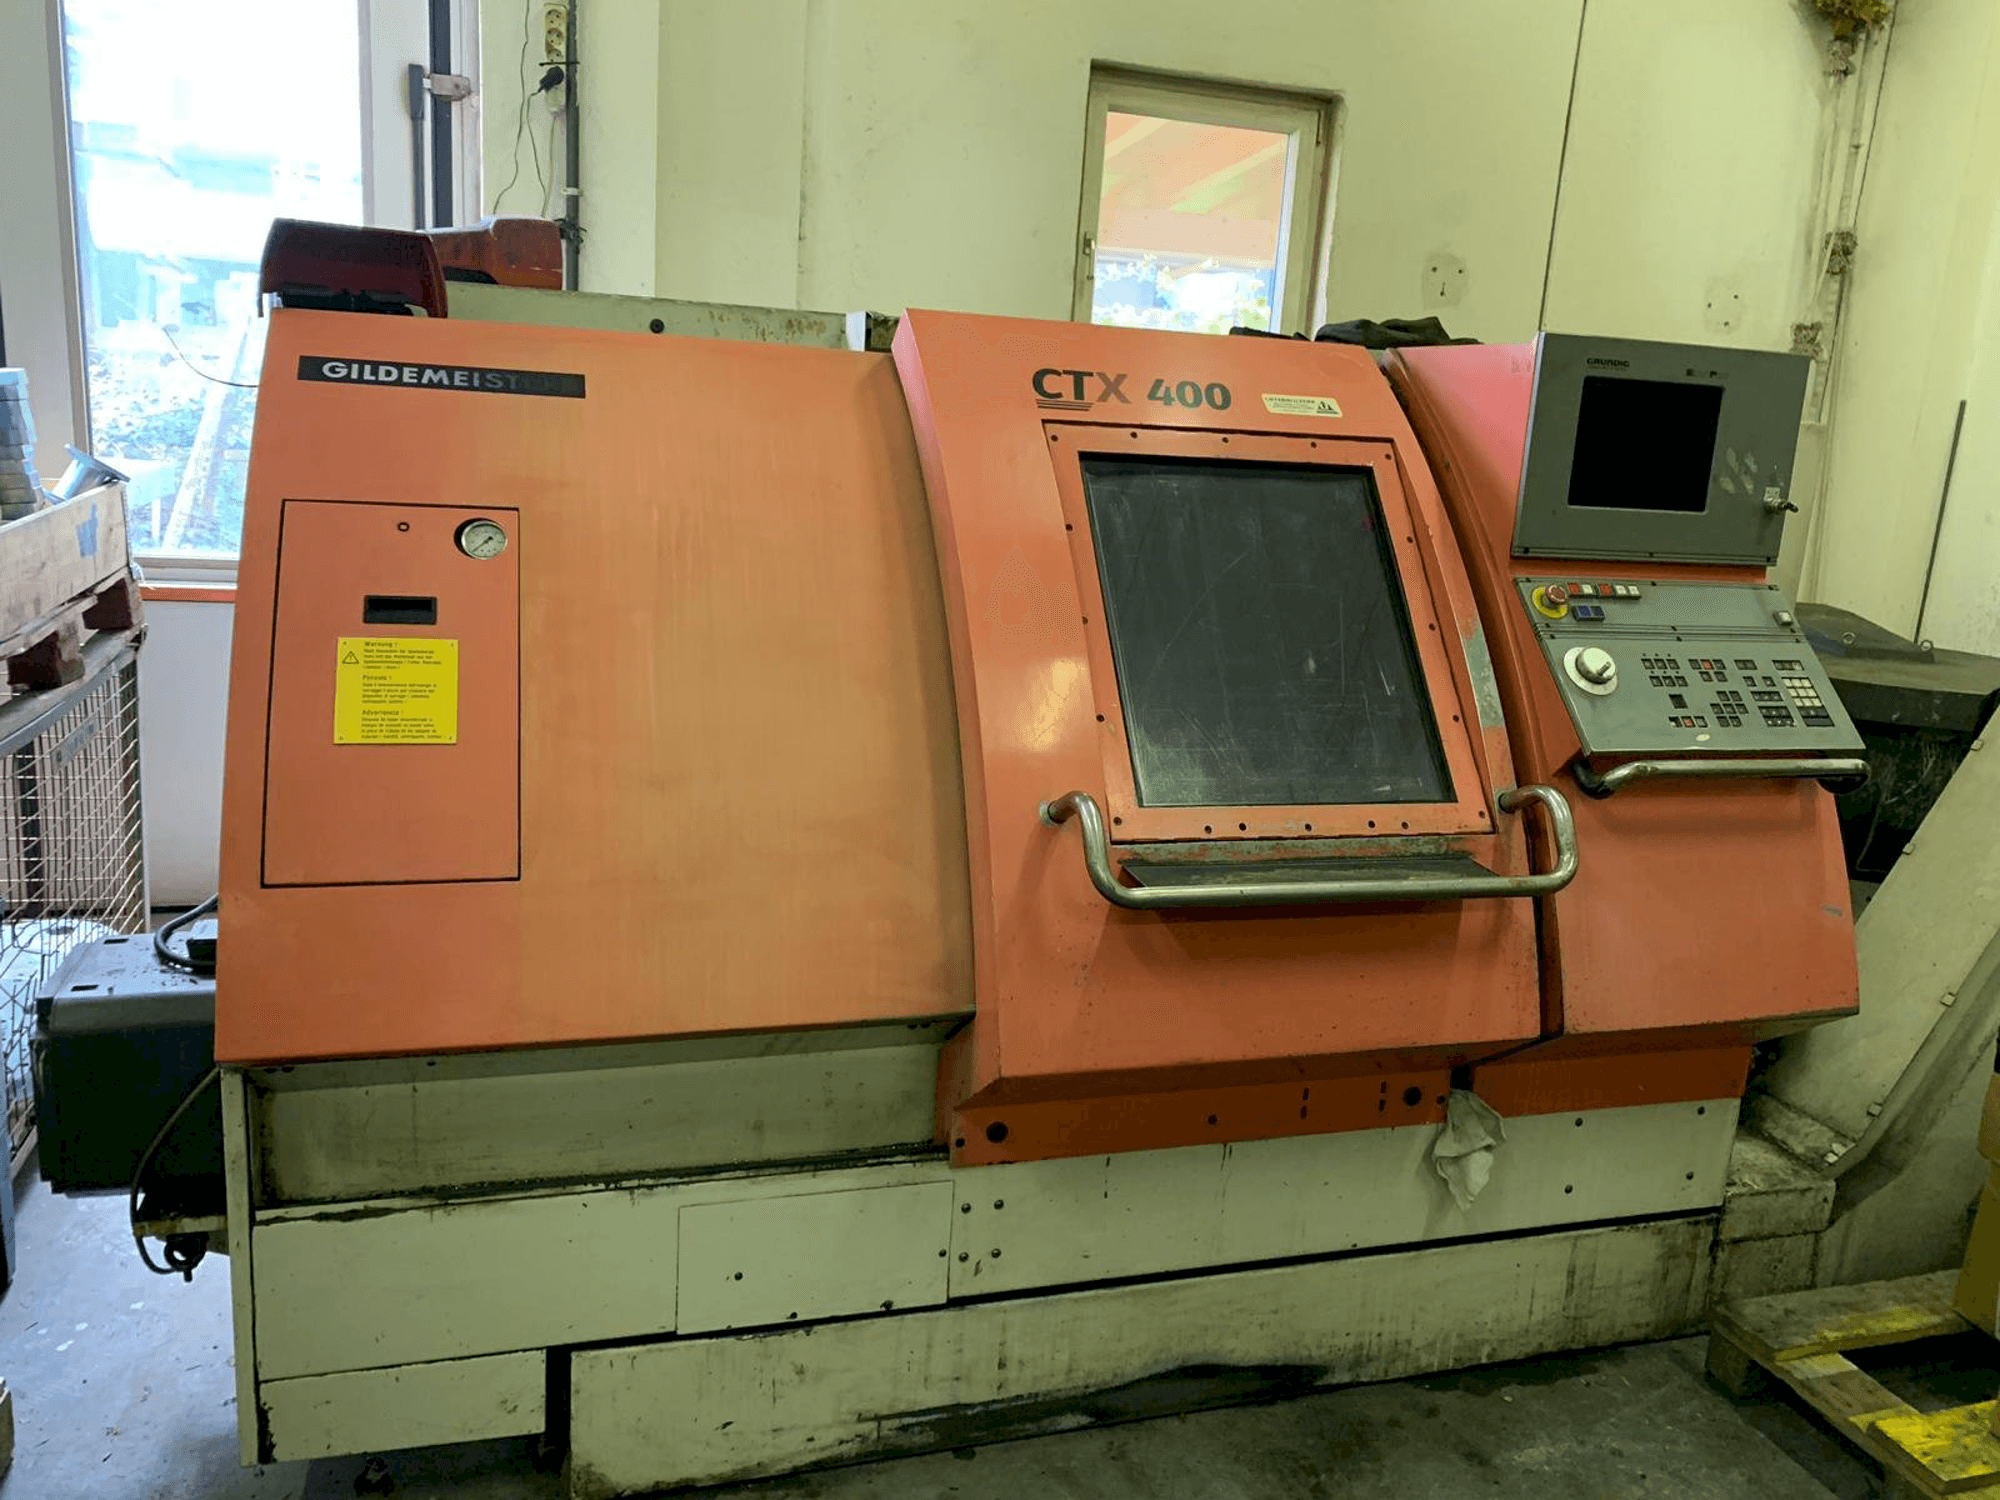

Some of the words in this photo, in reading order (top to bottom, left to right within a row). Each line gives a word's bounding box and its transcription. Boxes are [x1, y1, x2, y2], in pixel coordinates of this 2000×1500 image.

[321, 361, 578, 393] GILDEMEIST
[1586, 357, 1630, 367] GRUNDIG
[1032, 368, 1132, 404] CTX
[1147, 378, 1233, 411] 400
